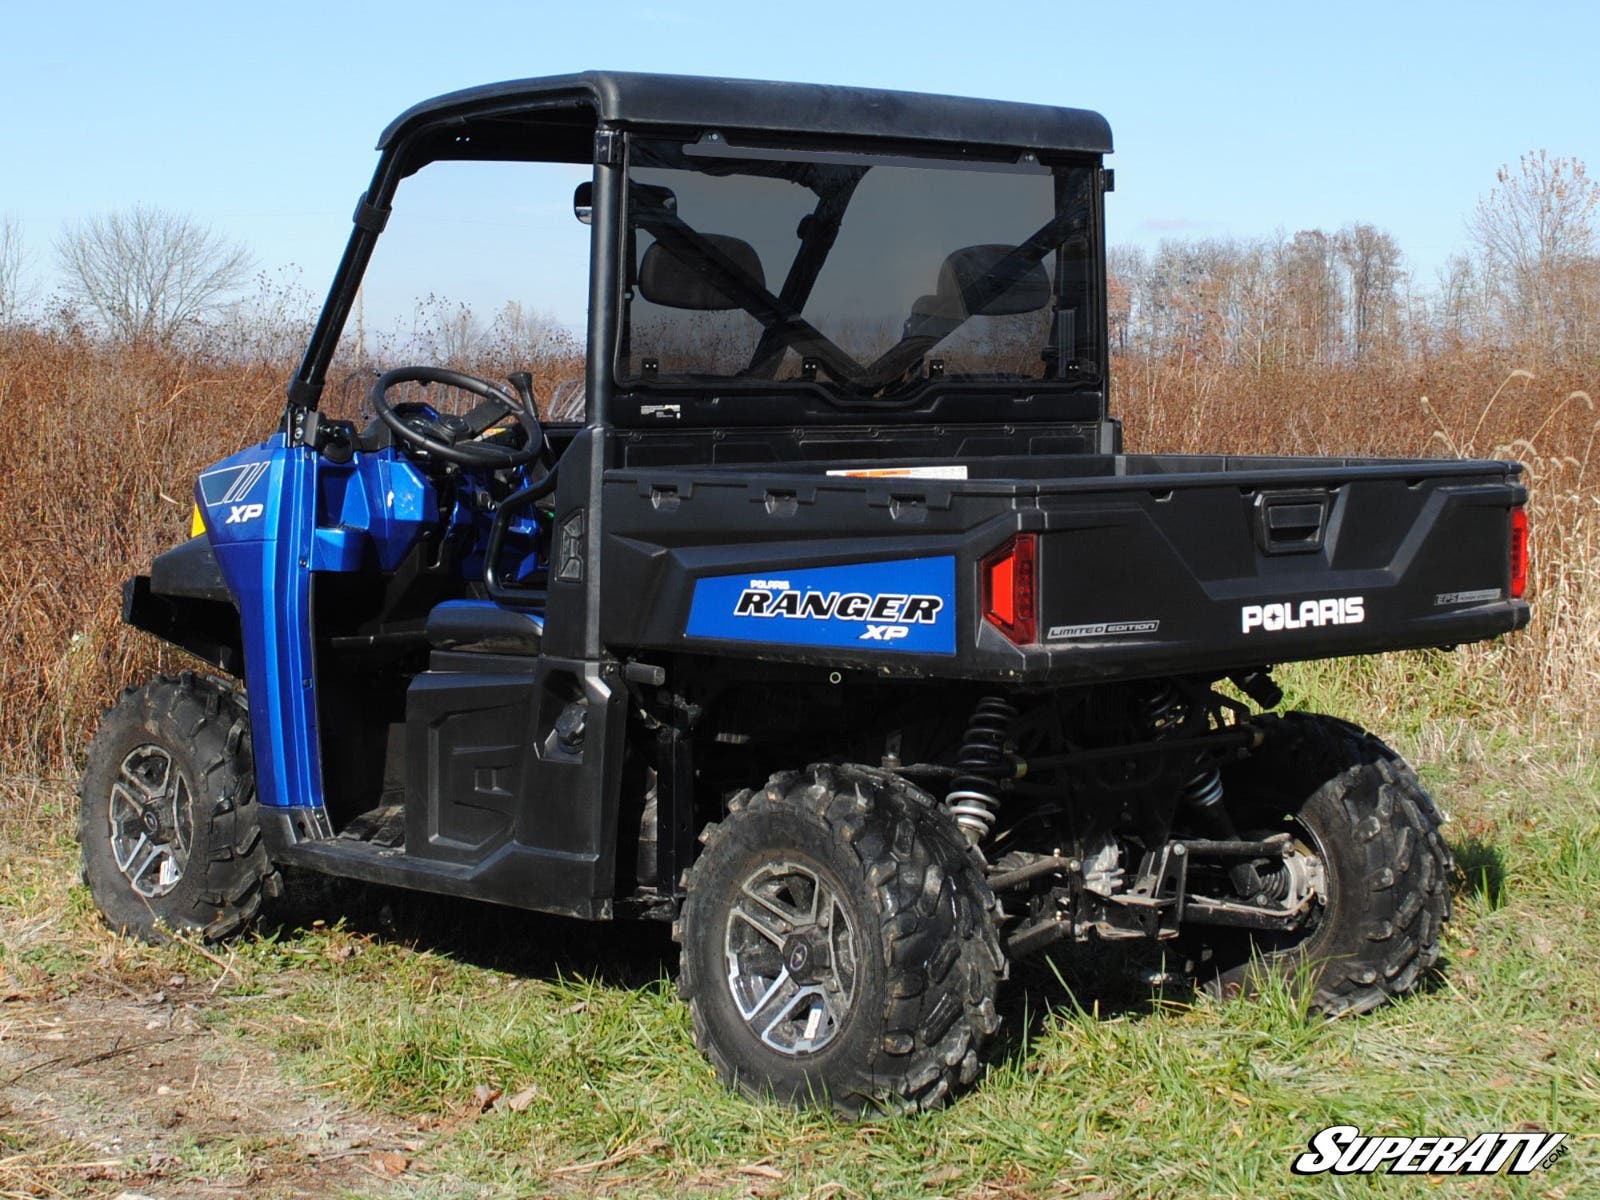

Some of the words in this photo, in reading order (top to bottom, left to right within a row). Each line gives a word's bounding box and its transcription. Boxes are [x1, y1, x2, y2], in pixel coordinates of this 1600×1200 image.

[225, 503, 264, 524] XP
[750, 580, 790, 590] POLARIS
[733, 589, 943, 624] RANGER
[1241, 596, 1365, 634] POLARIS
[858, 624, 909, 640] XP
[1050, 626, 1103, 637] LIMITED
[1106, 623, 1156, 633] EDITION
